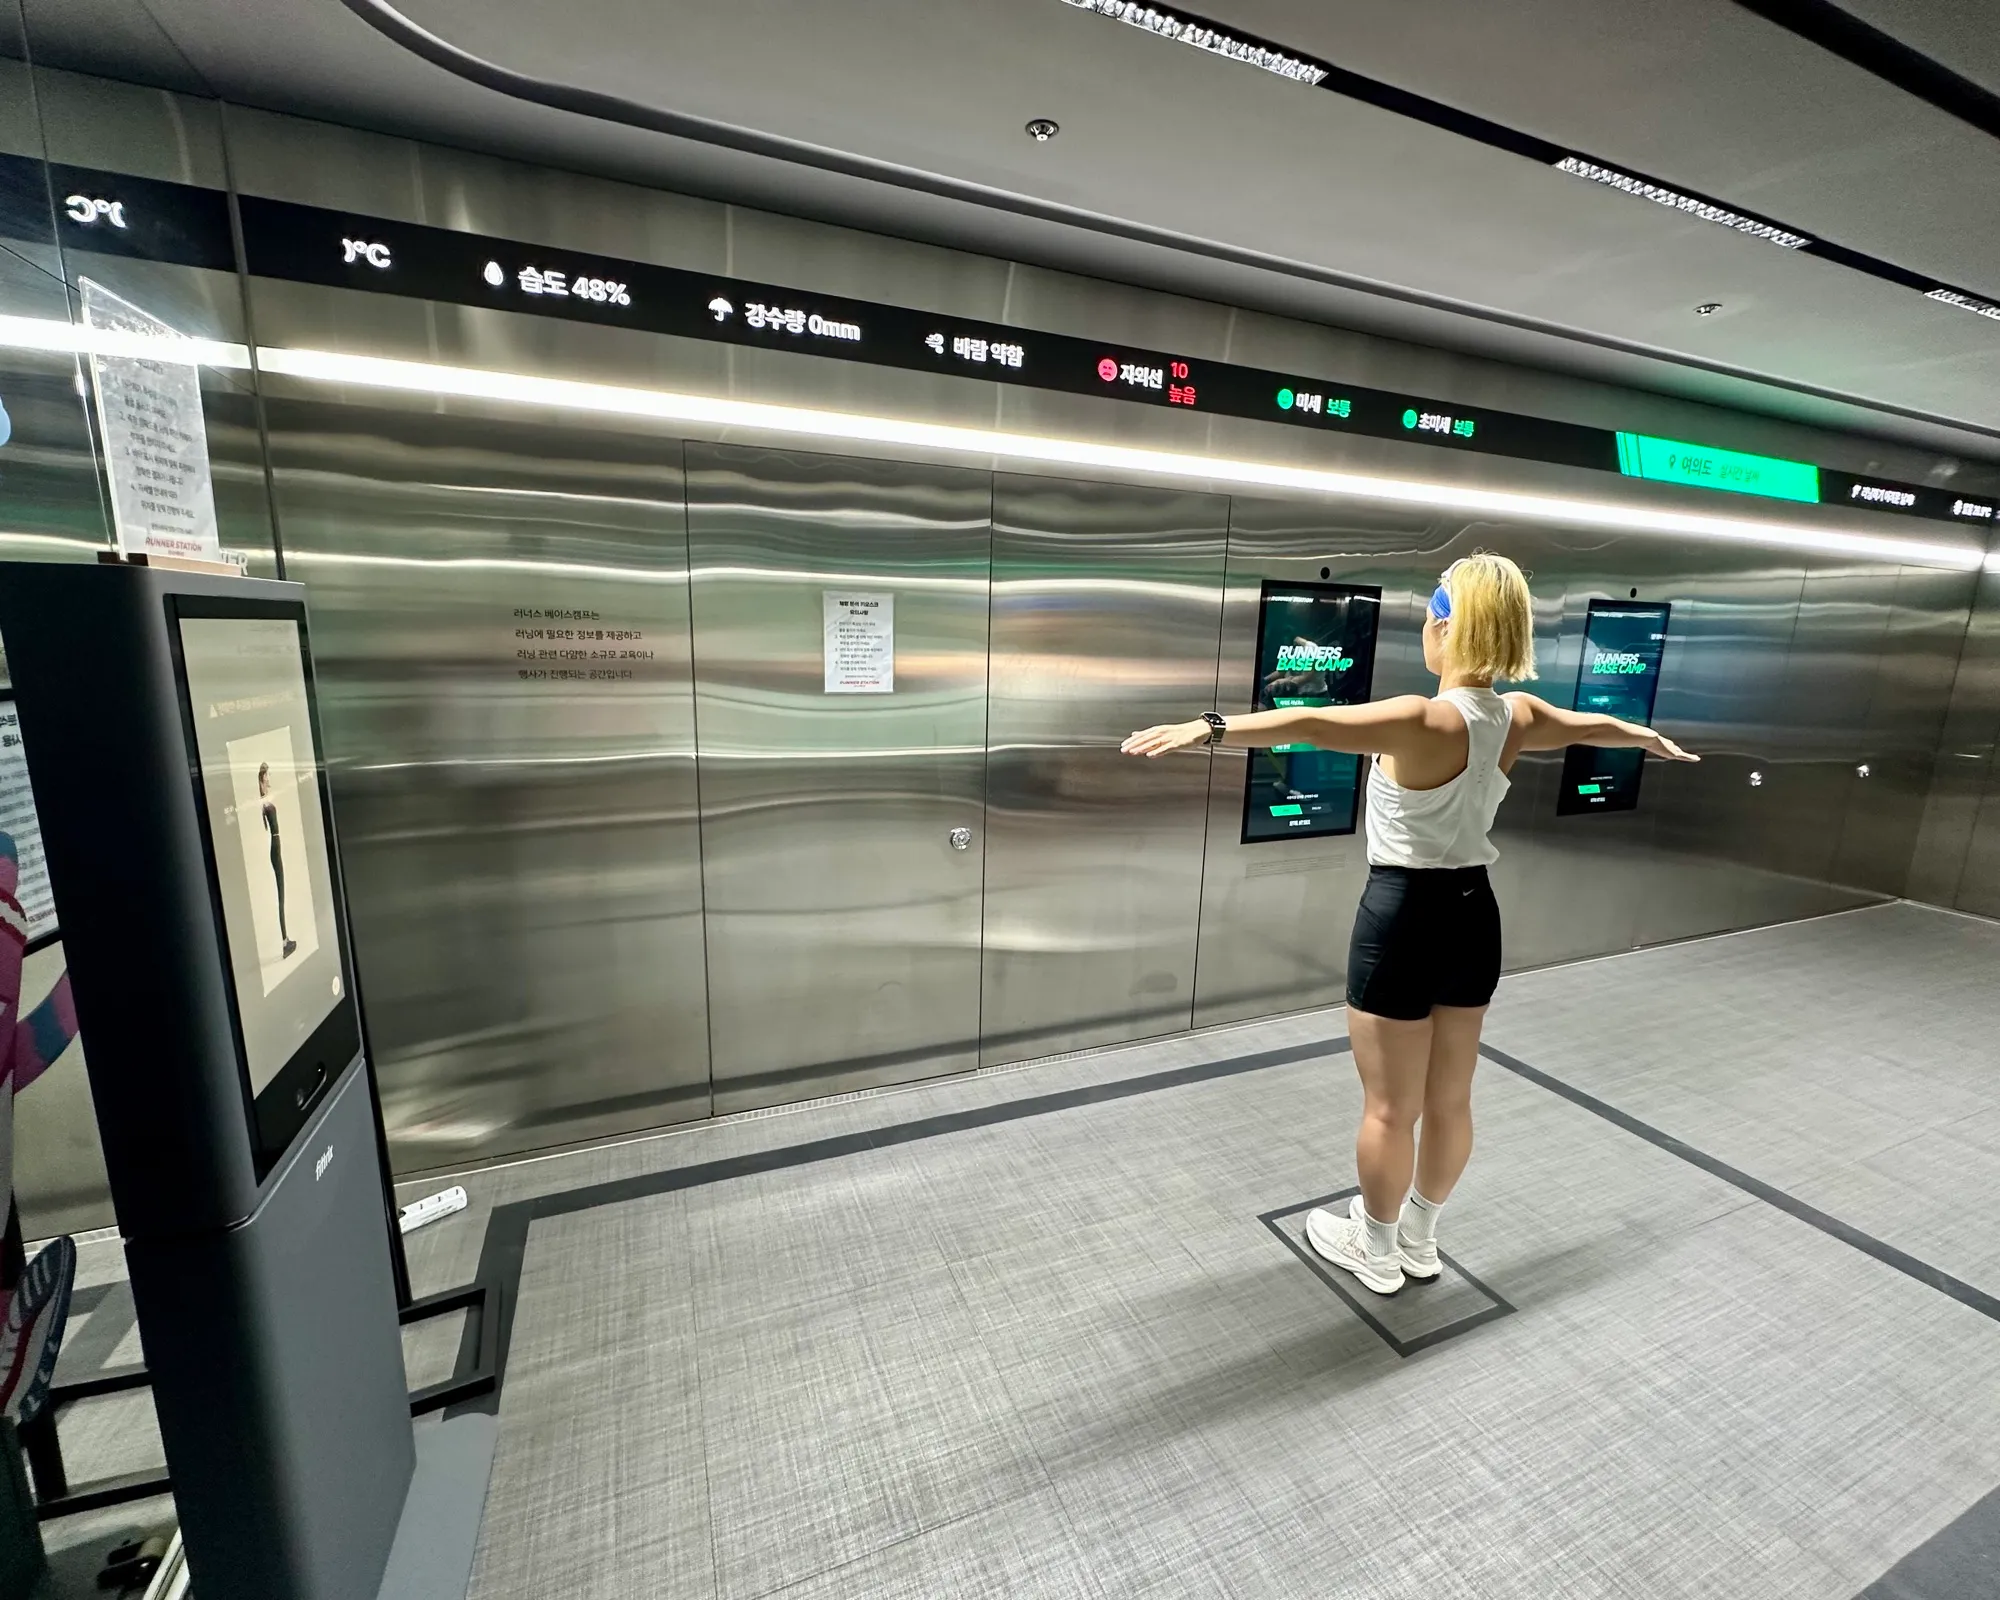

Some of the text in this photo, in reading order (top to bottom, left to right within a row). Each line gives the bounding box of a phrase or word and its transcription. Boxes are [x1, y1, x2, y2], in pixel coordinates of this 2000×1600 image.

[517, 266, 631, 307] 습도 48%
[744, 303, 861, 343] 강수량 0mm
[953, 338, 1025, 369] 바람 약함
[1119, 361, 1189, 391] 자외선 10
[1168, 383, 1197, 406] 높음
[1295, 393, 1352, 419] 미세 보통
[1418, 412, 1475, 438] 초미세 보통
[1681, 456, 1713, 476] 여의도
[145, 536, 202, 552] RUNNER STATION
[514, 608, 600, 621] 러너스 베이스캠프는
[515, 629, 643, 640] 러닝에 필요한 정보를 제공하고
[516, 649, 654, 661] 러닝 관련 다양한 소규모 교육이나
[1277, 645, 1343, 660] RUNNERS
[1595, 653, 1639, 664] RUNNERS
[1276, 658, 1354, 672] BASE CAMP
[1592, 664, 1646, 674] BASE CAMP
[518, 669, 633, 680] 행사가 진행되는 공간입니다
